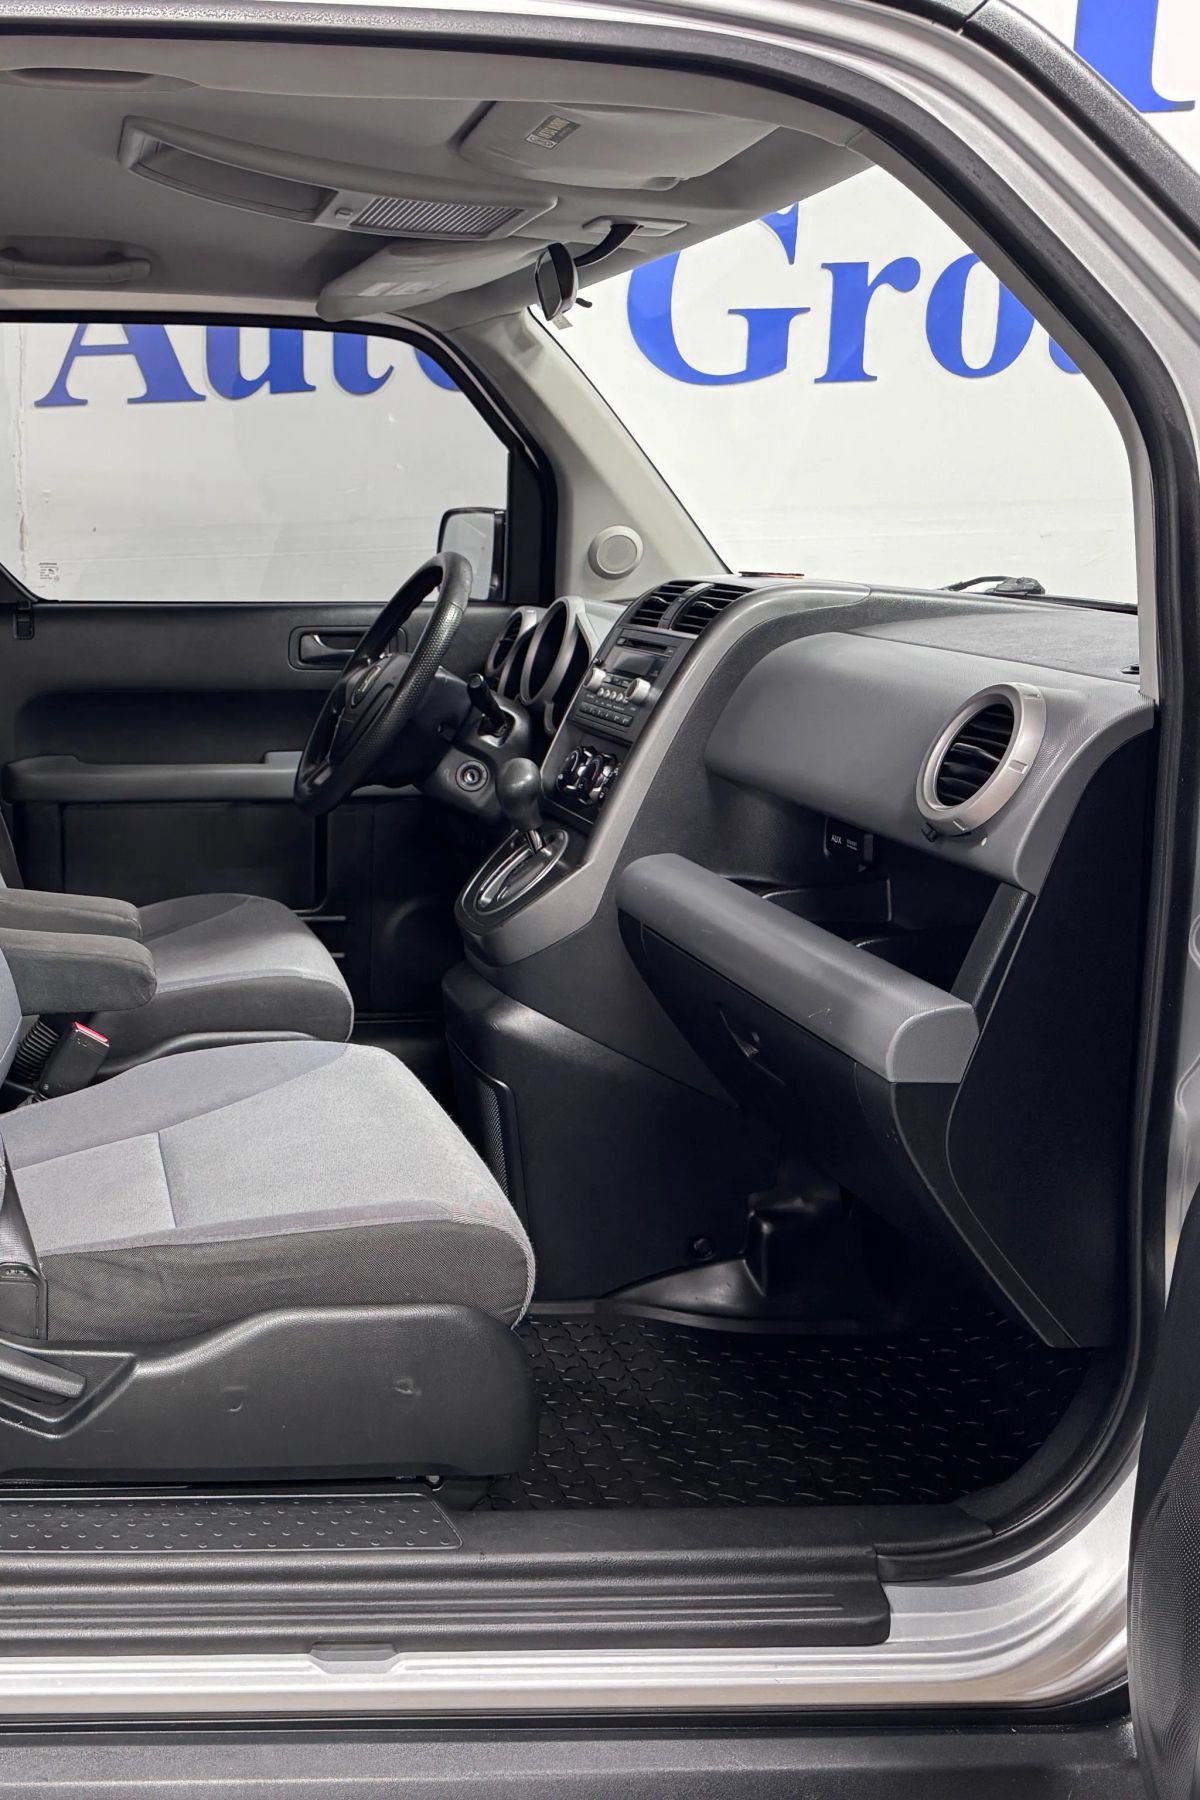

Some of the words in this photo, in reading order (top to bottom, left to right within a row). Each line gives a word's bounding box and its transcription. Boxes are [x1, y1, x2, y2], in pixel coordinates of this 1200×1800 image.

[33, 322, 462, 408] Aut
[626, 202, 1085, 386] Gro
[831, 834, 842, 845] AUX
